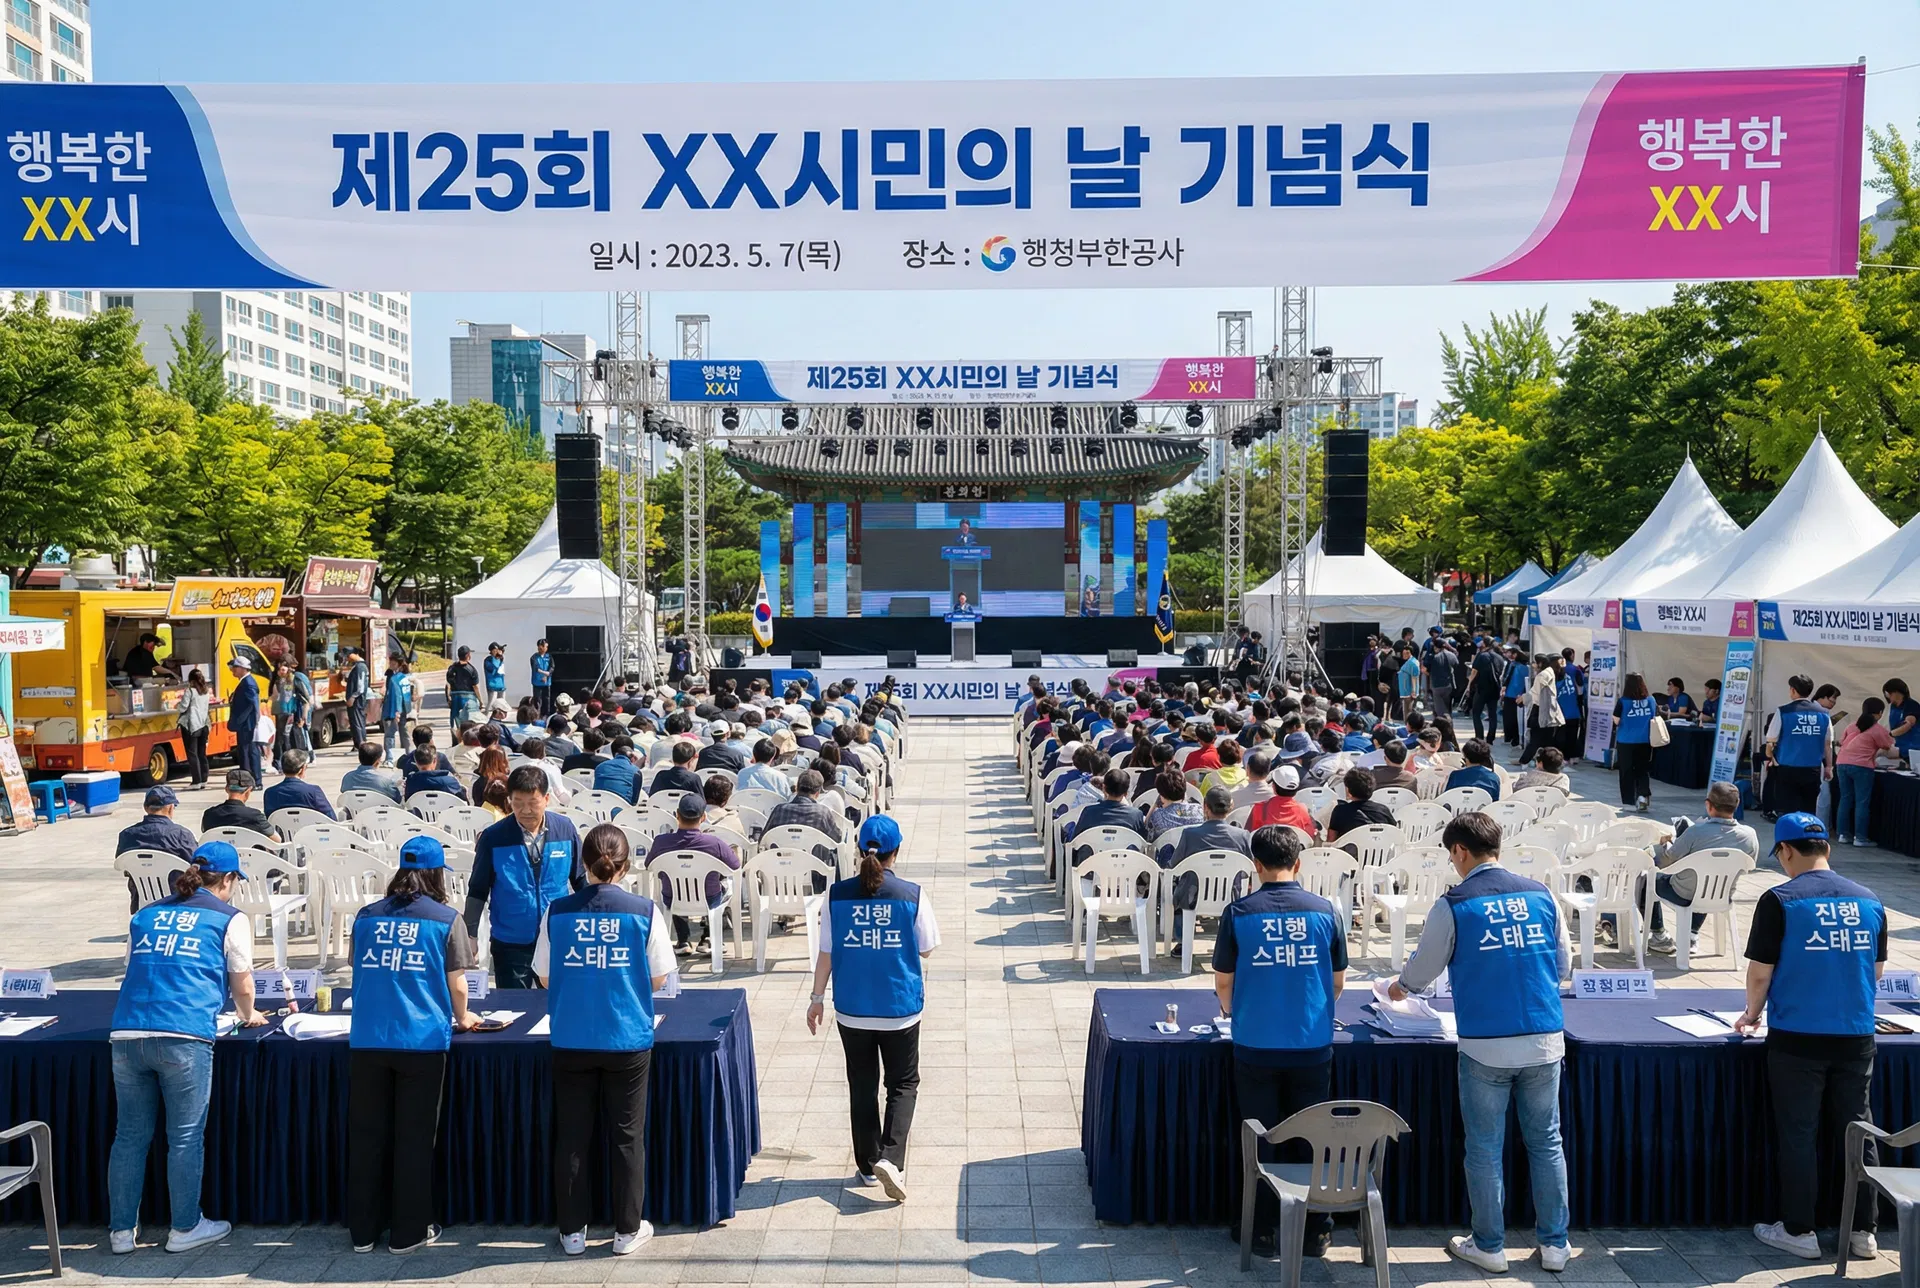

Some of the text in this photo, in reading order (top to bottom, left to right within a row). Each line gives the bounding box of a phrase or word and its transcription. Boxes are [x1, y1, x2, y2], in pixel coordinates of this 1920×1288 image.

[1639, 116, 1787, 171] 행복한
[7, 131, 151, 182] 행복한
[333, 123, 1429, 211] 제25회 XX시민의 날 기념식
[1649, 181, 1769, 233] XX시
[22, 194, 139, 245] XX시
[590, 242, 639, 270] 일시
[780, 240, 840, 271] 7(목)
[903, 240, 955, 268] 장소
[1023, 238, 1184, 267] 행청부한공사
[705, 382, 738, 396] XX시
[807, 365, 1117, 389] 제25회 XX시민의 날 기념식
[1188, 379, 1221, 394] XX시
[1684, 605, 1706, 622] XX시
[1793, 609, 1823, 628] 제25회
[1825, 610, 1869, 630] XX시민의
[1873, 611, 1884, 631] 날
[1887, 612, 1920, 633] 기념식
[923, 682, 999, 700] XX시민의
[1005, 682, 1020, 700] 날
[153, 910, 200, 932] 진행
[852, 905, 891, 925] 진행
[1483, 897, 1530, 924] 진행
[1815, 902, 1860, 925] 진행
[375, 921, 419, 945] 진행
[575, 919, 620, 942] 진행
[844, 929, 902, 949] 스태프
[1263, 917, 1306, 940] 진행
[1479, 923, 1547, 951] 스태프
[1805, 929, 1870, 951] 스태프
[133, 933, 201, 958] 스태프
[1253, 944, 1318, 966] 스태프
[362, 948, 427, 971] 스태프
[564, 946, 630, 971] 스태프
